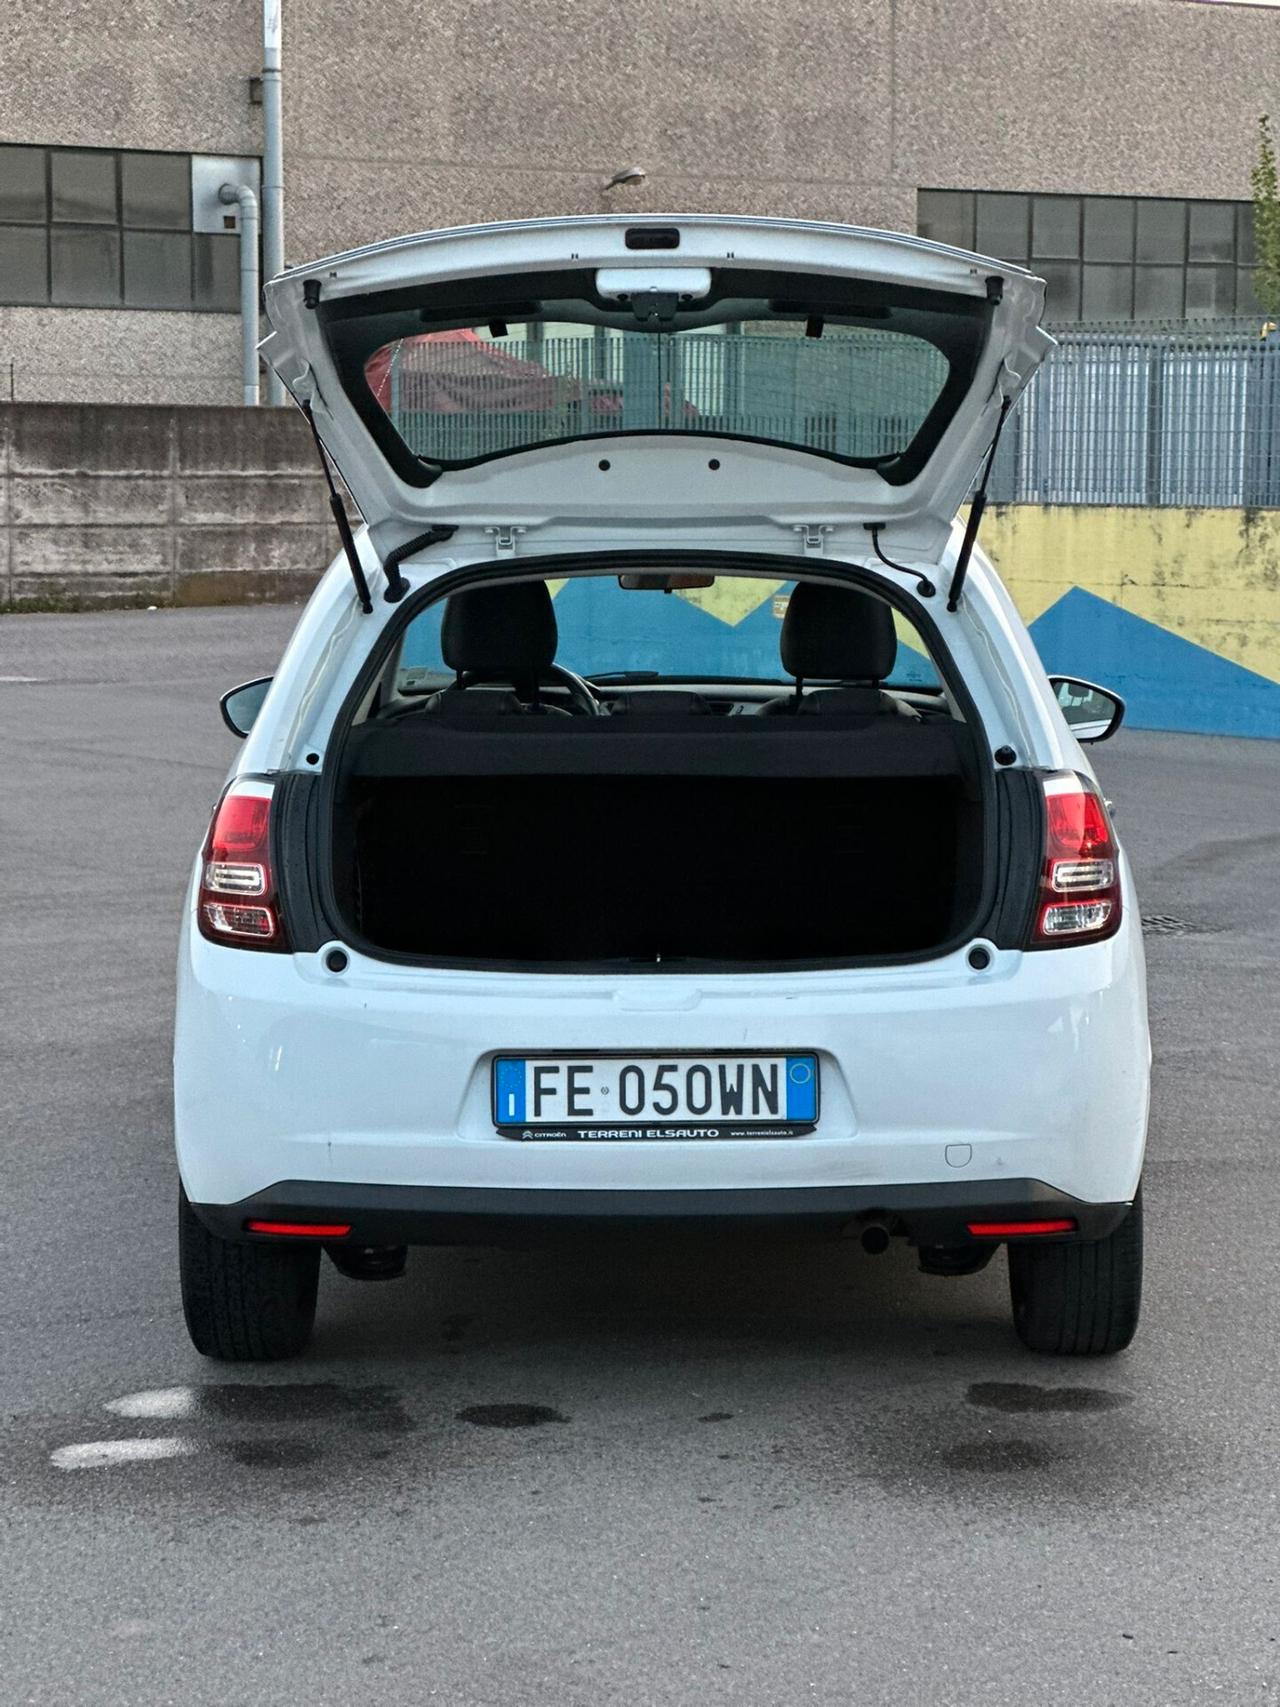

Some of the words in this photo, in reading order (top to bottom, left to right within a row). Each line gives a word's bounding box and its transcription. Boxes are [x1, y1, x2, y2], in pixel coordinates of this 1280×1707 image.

[508, 1093, 515, 1116] I
[533, 1065, 594, 1117] FE
[619, 1064, 779, 1116] 050WN
[577, 1130, 642, 1139] TERRENI
[646, 1129, 719, 1138] ELSAUTO
